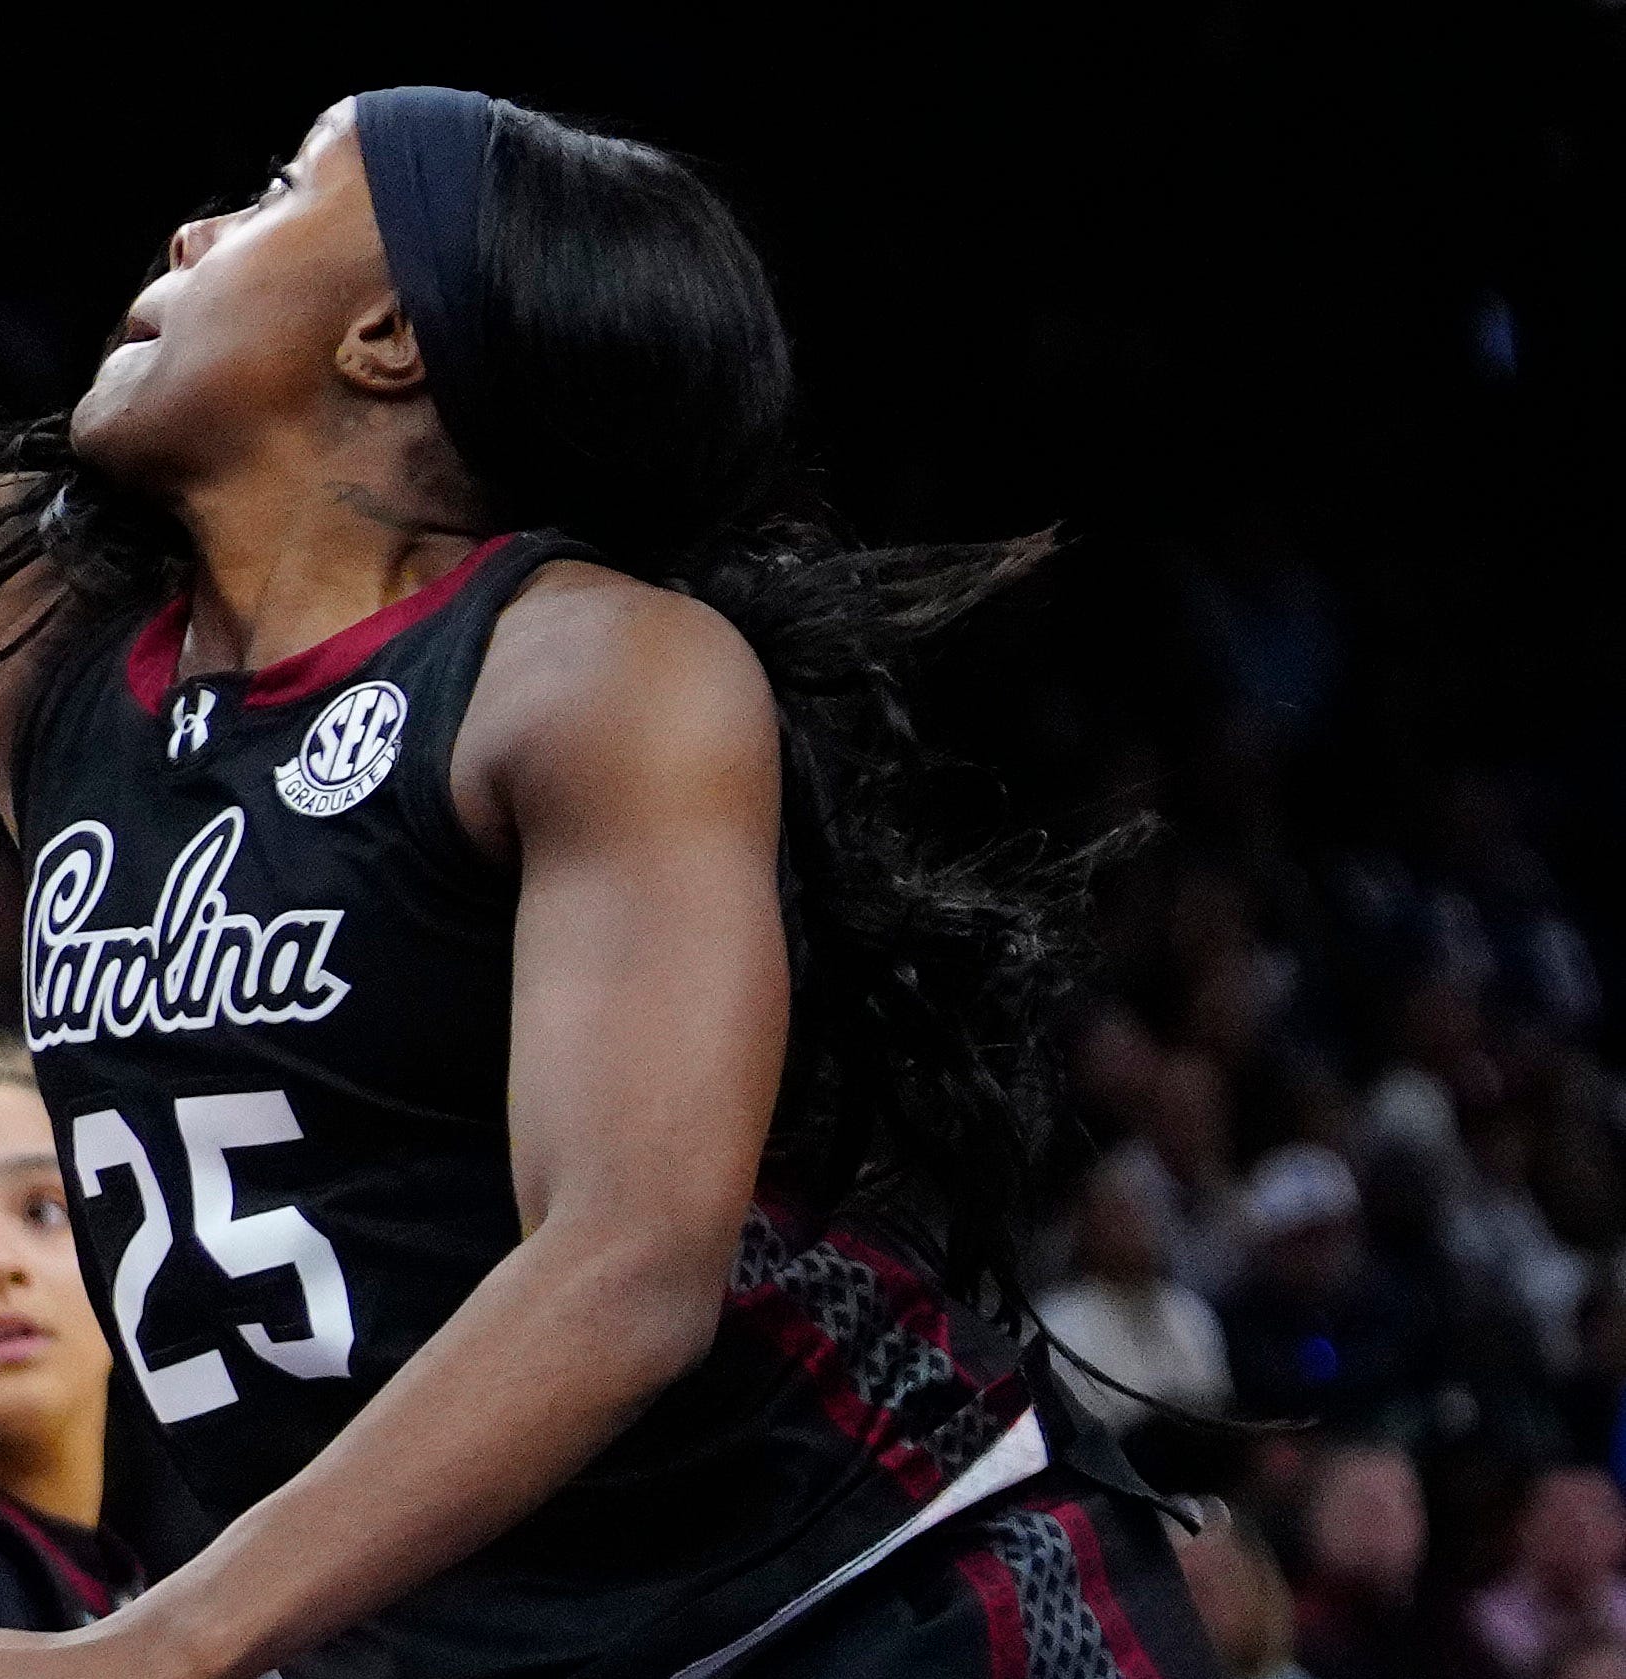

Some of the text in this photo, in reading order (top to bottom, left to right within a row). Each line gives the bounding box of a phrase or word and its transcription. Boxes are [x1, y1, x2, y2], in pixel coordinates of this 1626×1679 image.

[284, 768, 384, 814] GRADUATE
[307, 686, 399, 783] SEC
[22, 805, 351, 1053] Carolina
[72, 1088, 356, 1425] 25
